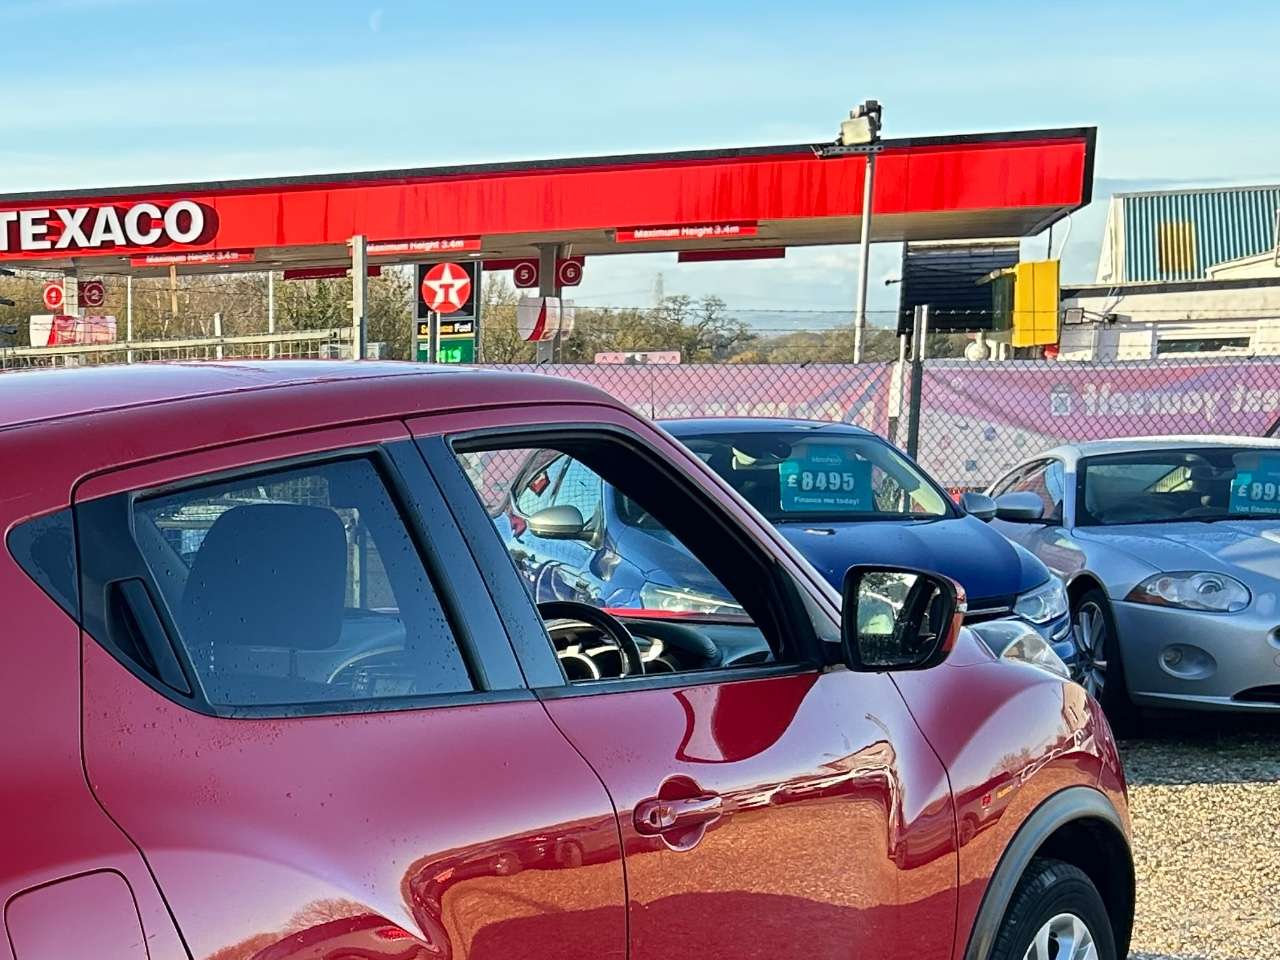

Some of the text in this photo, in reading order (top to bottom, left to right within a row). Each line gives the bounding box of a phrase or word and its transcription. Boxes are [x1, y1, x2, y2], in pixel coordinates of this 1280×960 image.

[681, 227, 713, 238] Height
[519, 269, 529, 280] 5
[566, 267, 576, 278] 6
[89, 289, 101, 300] 2
[787, 471, 855, 491] £8495
[1237, 482, 1280, 501] £89
